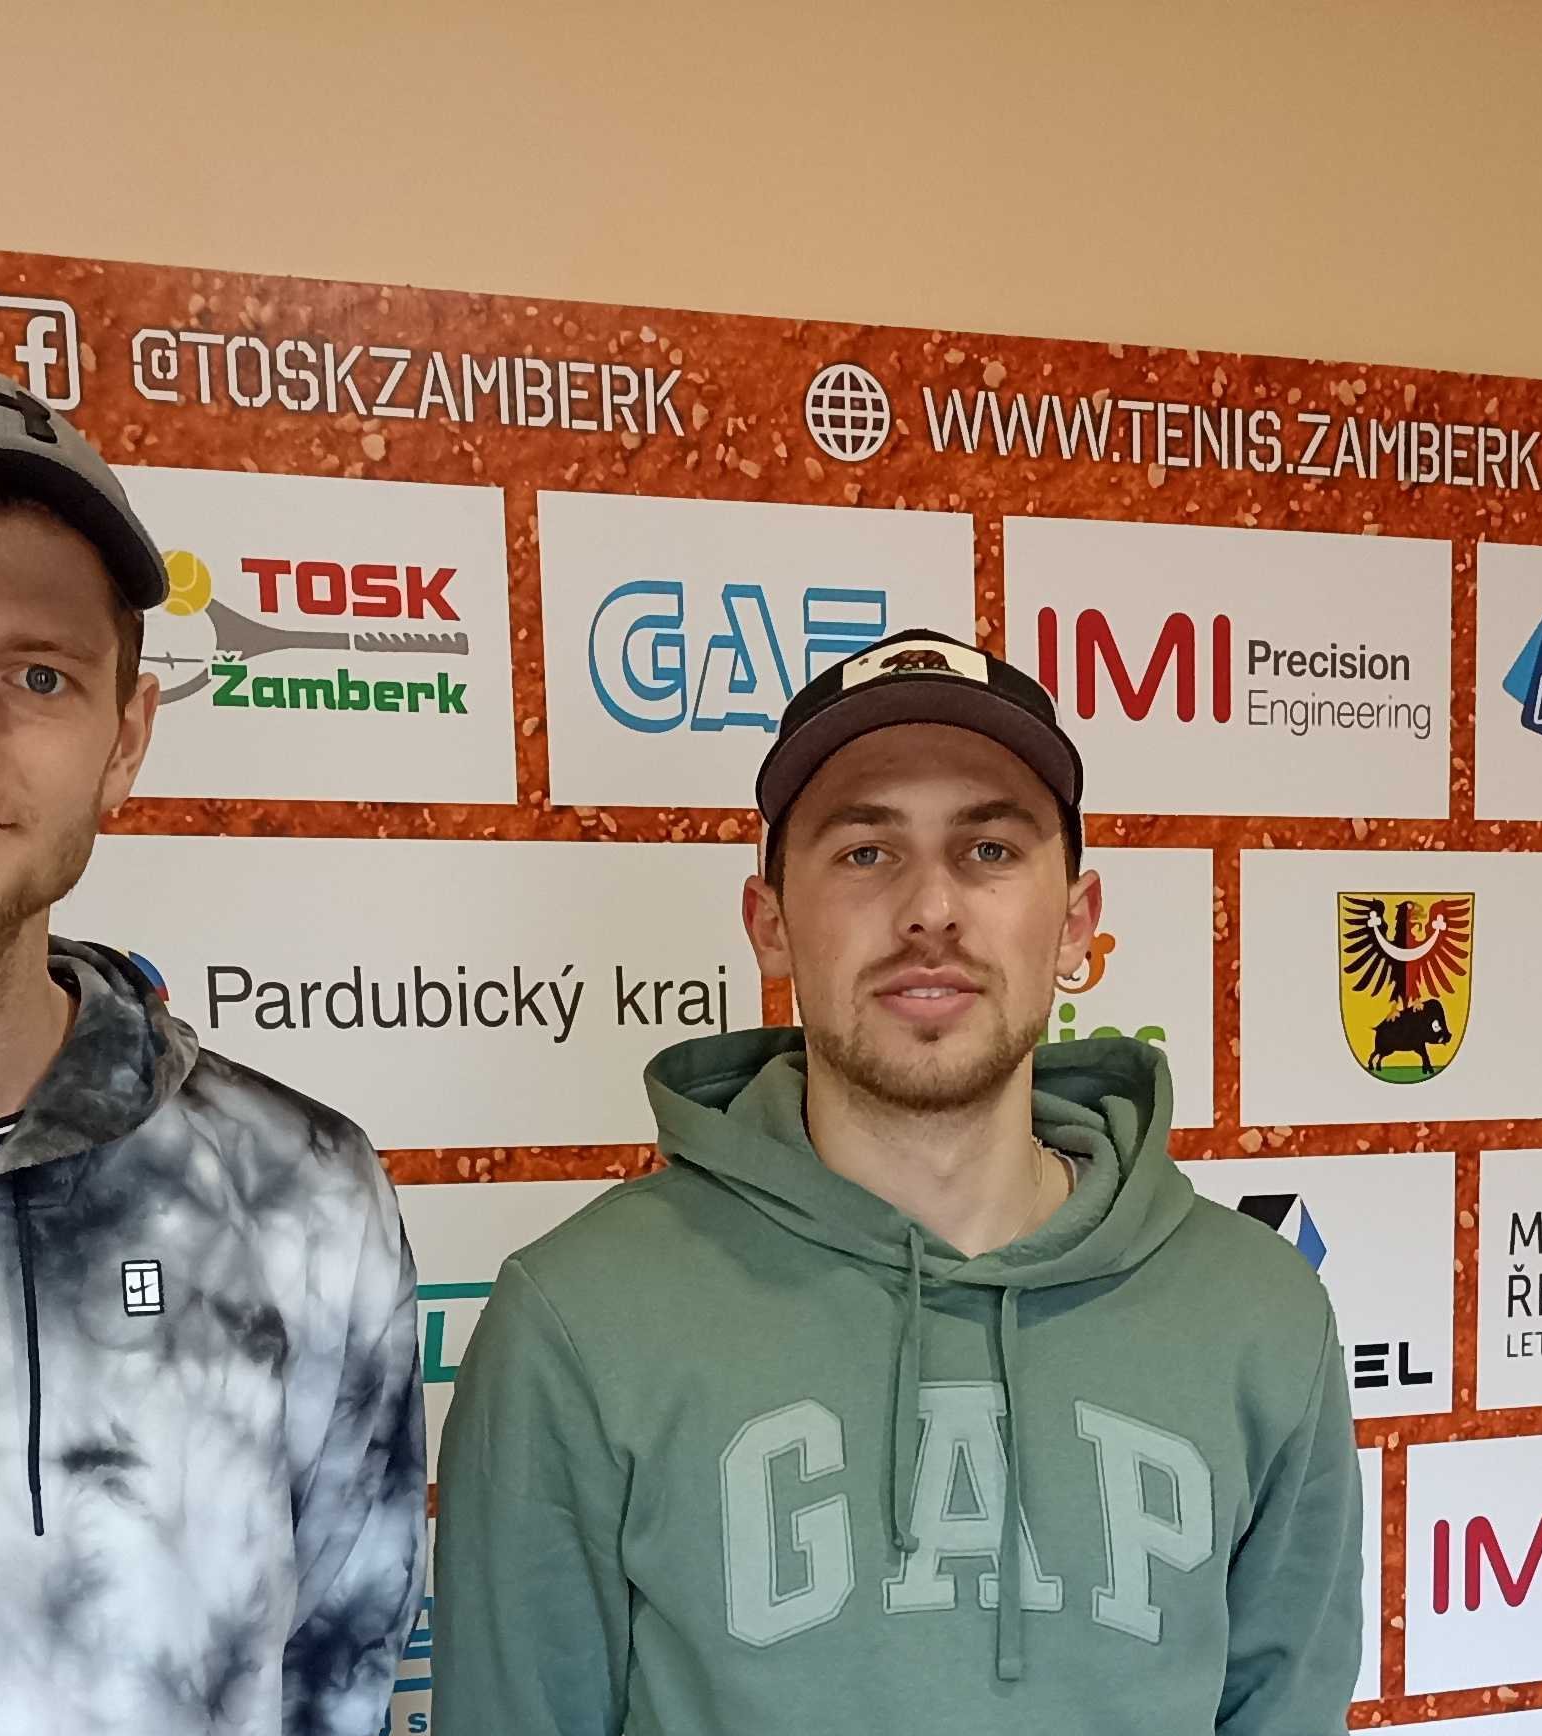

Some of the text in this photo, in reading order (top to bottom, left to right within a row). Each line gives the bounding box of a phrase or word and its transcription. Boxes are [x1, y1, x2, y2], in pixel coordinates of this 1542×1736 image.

[131, 327, 685, 436] @TOSKZAMBERK
[241, 556, 462, 622] TOSK
[210, 650, 469, 715] Žamberk
[1037, 606, 1232, 725] IMI
[1247, 639, 1411, 682] Precision
[1247, 688, 1432, 740] Engineering
[205, 963, 730, 1044] Pardubický kraj
[719, 1380, 1214, 1650] GAP
